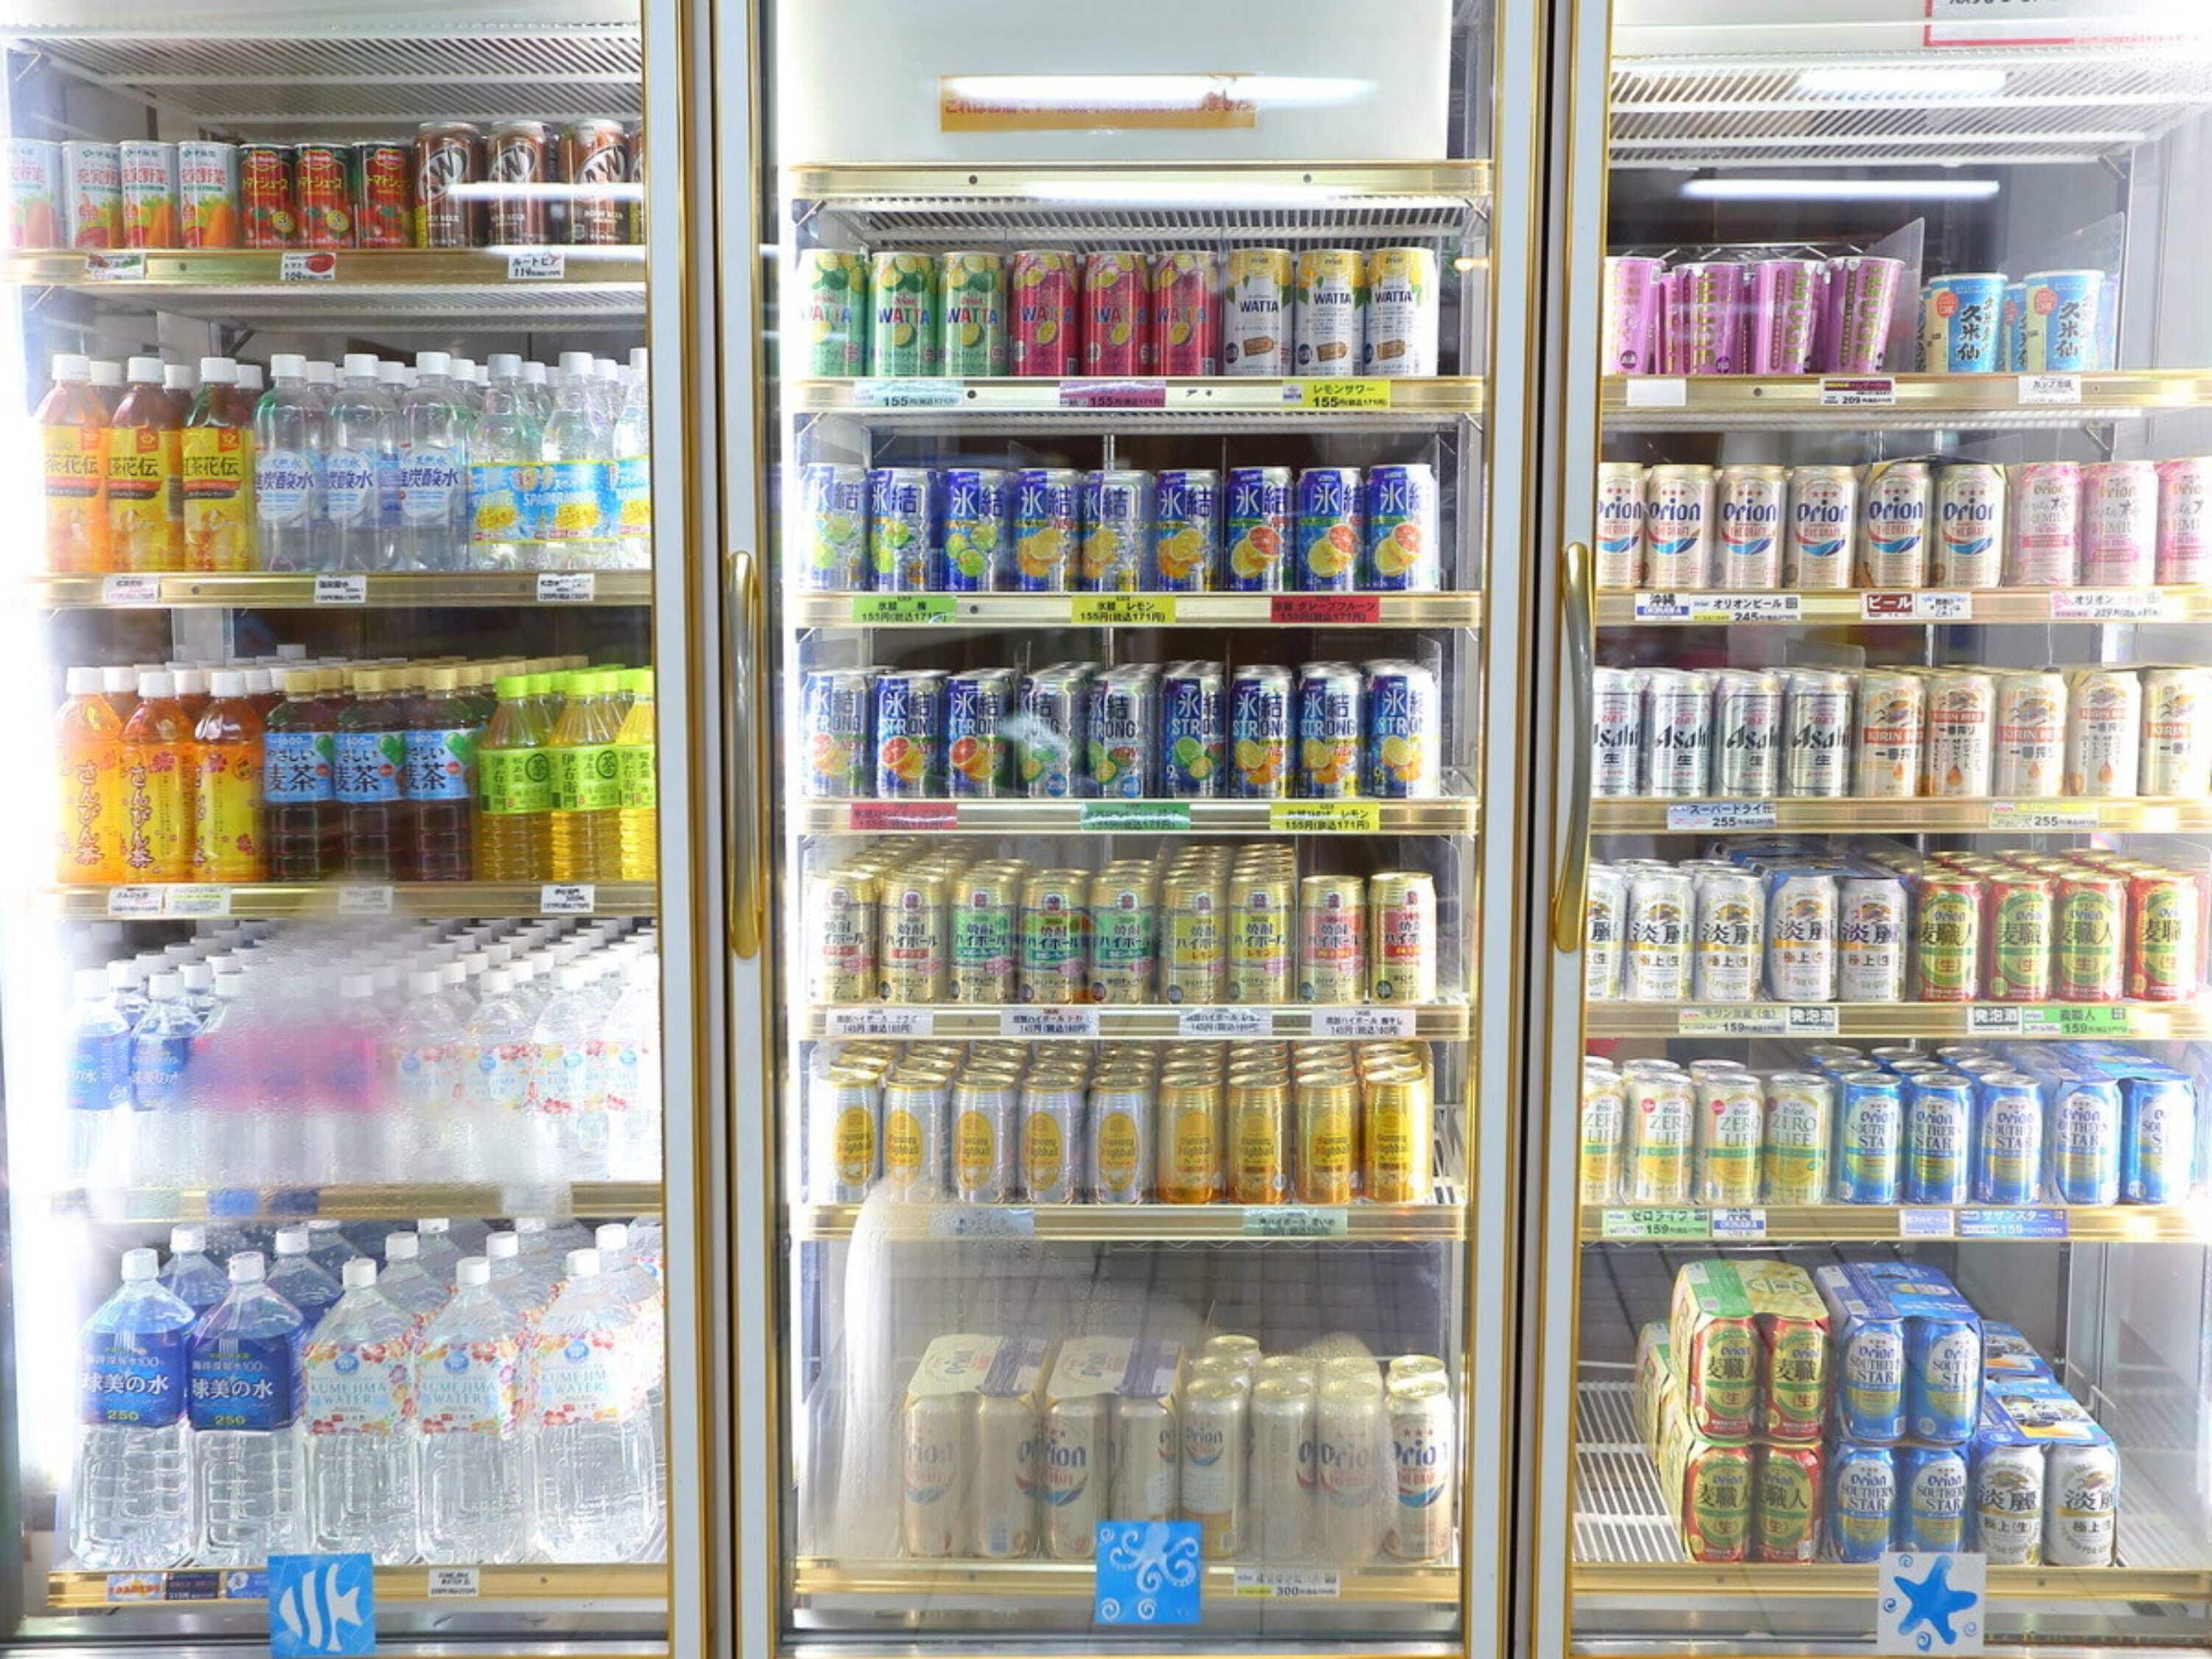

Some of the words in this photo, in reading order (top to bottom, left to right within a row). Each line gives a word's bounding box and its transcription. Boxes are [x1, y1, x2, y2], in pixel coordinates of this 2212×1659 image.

[512, 258, 562, 267] ルートビア
[1313, 291, 1352, 305] WATTA
[1374, 290, 1413, 304] WATTA
[1239, 299, 1279, 313] WATTA
[802, 307, 852, 324] ATTA
[879, 307, 930, 325] WATTA
[947, 307, 998, 325] WATTA
[1156, 306, 1208, 323] WATTA
[1956, 303, 1983, 361] 久米仙
[2054, 301, 2081, 358] 久米仙
[1313, 384, 1376, 394] レモンサワー
[872, 481, 917, 513] 氷結
[953, 485, 1004, 517] 氷結
[1020, 486, 1075, 516] 氷結
[1160, 486, 1212, 517] 氷結
[1236, 485, 1288, 516] 氷結
[1649, 497, 1700, 521] Orion
[1723, 498, 1776, 522] Orion
[1868, 495, 1923, 521] Orion
[1126, 602, 1155, 611] レモン
[1297, 601, 1376, 612] グレープフルーツ
[1649, 593, 1676, 605] 沖縄
[1713, 597, 1782, 609] オリオンビール
[1867, 595, 1913, 609] ビール
[2074, 594, 2114, 605] オリオン
[884, 691, 929, 717] 氷結
[954, 692, 1001, 717] 氷結
[1237, 693, 1282, 718] 氷結
[1304, 692, 1349, 718] 氷結
[1233, 719, 1288, 737] STRONG
[1301, 719, 1357, 737] STRONG
[1867, 730, 1900, 742] KIRIN
[1604, 753, 1621, 765] 生
[1676, 754, 1694, 765] 生
[1749, 754, 1764, 765] 生
[1815, 754, 1832, 765] 生
[268, 765, 316, 793] 麦茶
[335, 765, 379, 793] 麦茶
[77, 760, 105, 866] さんぴん茶
[1340, 810, 1369, 819] レモン
[1689, 803, 1763, 815] スーパードライ
[129, 765, 154, 869] さんぴん茶
[886, 935, 938, 948] ハイボール
[1027, 936, 1079, 949] ハイボール
[1234, 935, 1286, 947] ハイボール
[1790, 1009, 1834, 1025] 発泡酒
[1975, 1008, 2018, 1023] 発泡酒
[1649, 1116, 1691, 1131] ZERO
[1719, 1116, 1761, 1131] ZERO
[1771, 1116, 1817, 1132] ZERO
[1773, 1133, 1810, 1147] LIFE
[1916, 1137, 1952, 1150] STAR
[1631, 1210, 1688, 1222] ゼロライフ
[1982, 1211, 2048, 1222] サザンスター
[1859, 1345, 1895, 1357] Orion
[1857, 1369, 1895, 1383] STAR
[192, 1377, 274, 1399] 球美の水
[1851, 1474, 1887, 1487] Orion
[1927, 1474, 1961, 1487] Orion
[1842, 1484, 1894, 1499] SOUTHERN
[1979, 1488, 2037, 1510] 淡麗
[1849, 1498, 1888, 1512] STAR
[1924, 1498, 1962, 1512] STAR
